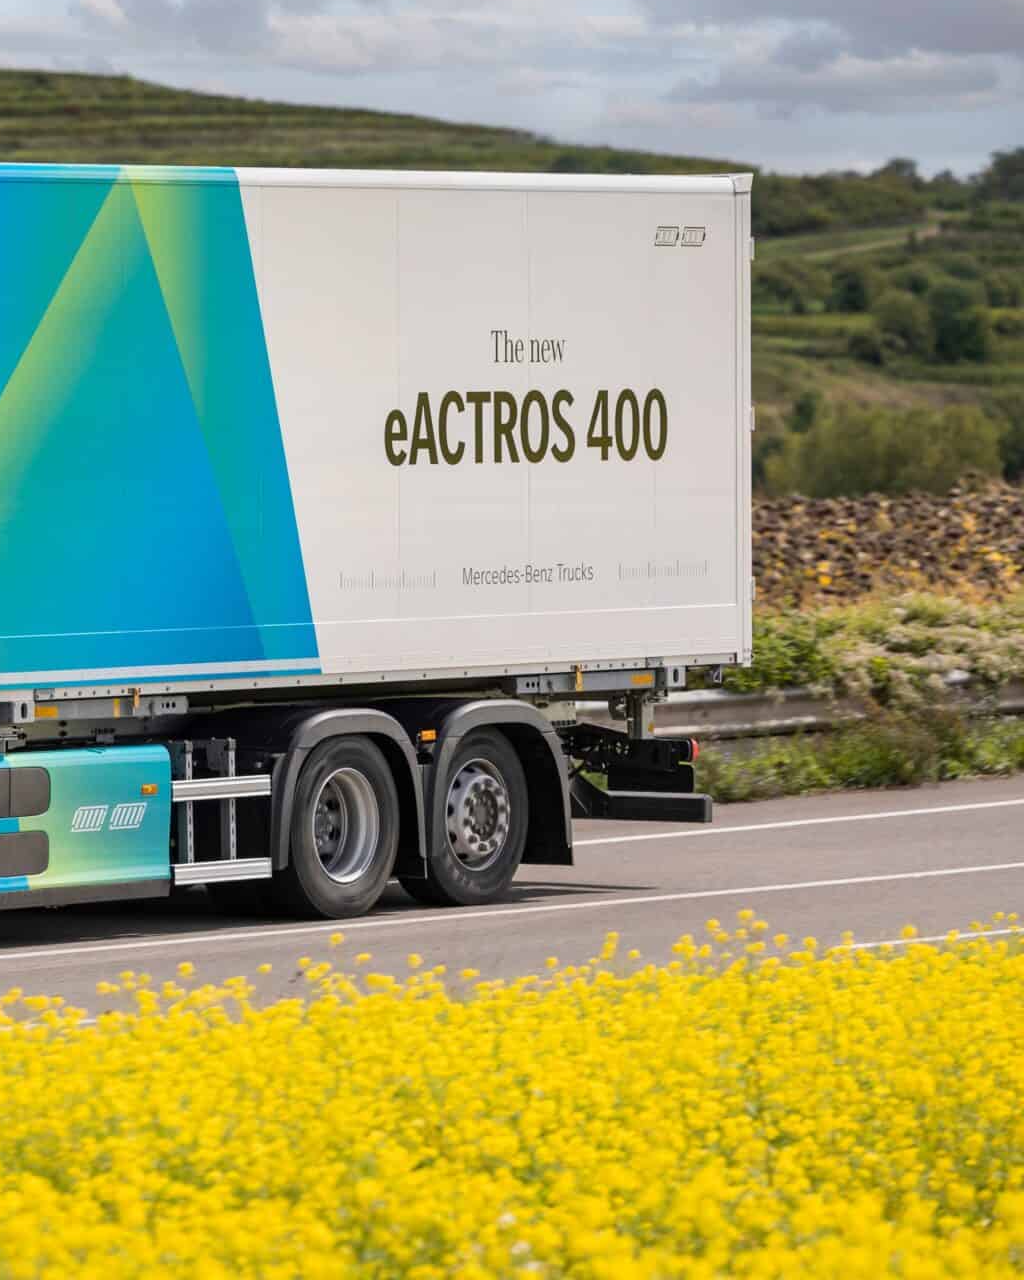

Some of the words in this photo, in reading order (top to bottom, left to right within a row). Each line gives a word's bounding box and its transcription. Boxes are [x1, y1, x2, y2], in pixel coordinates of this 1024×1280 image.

[491, 330, 525, 363] The
[529, 338, 566, 363] new
[384, 389, 576, 466] eACTROS
[587, 388, 669, 462] 400
[462, 564, 553, 585] Mercedes-Benz
[556, 561, 594, 582] Trucks
